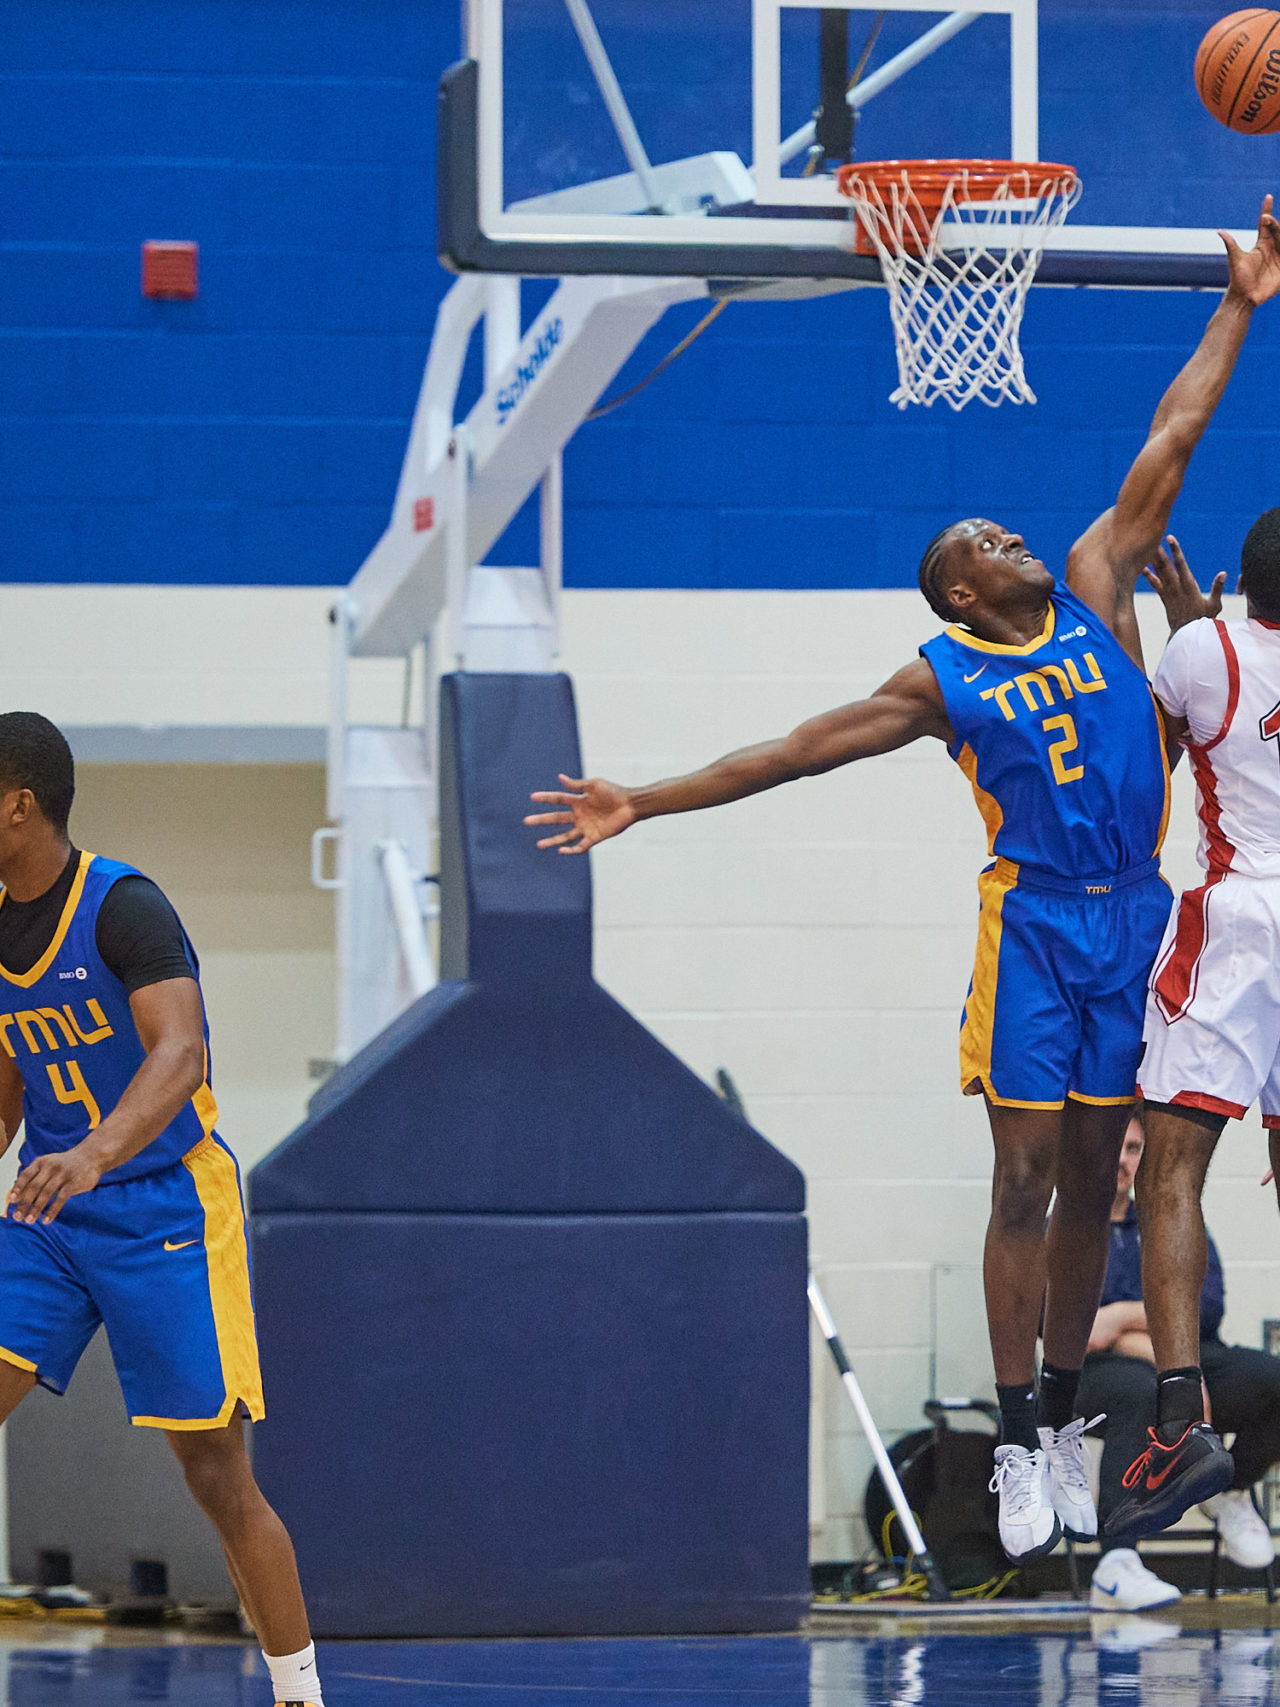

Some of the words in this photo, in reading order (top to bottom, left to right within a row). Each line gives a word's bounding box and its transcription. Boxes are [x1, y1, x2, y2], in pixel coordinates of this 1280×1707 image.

[979, 652, 1107, 721] TMU
[1042, 713, 1084, 785] 2
[1085, 884, 1112, 895] TMU
[0, 998, 114, 1058] TMU
[46, 1061, 101, 1129] 4
